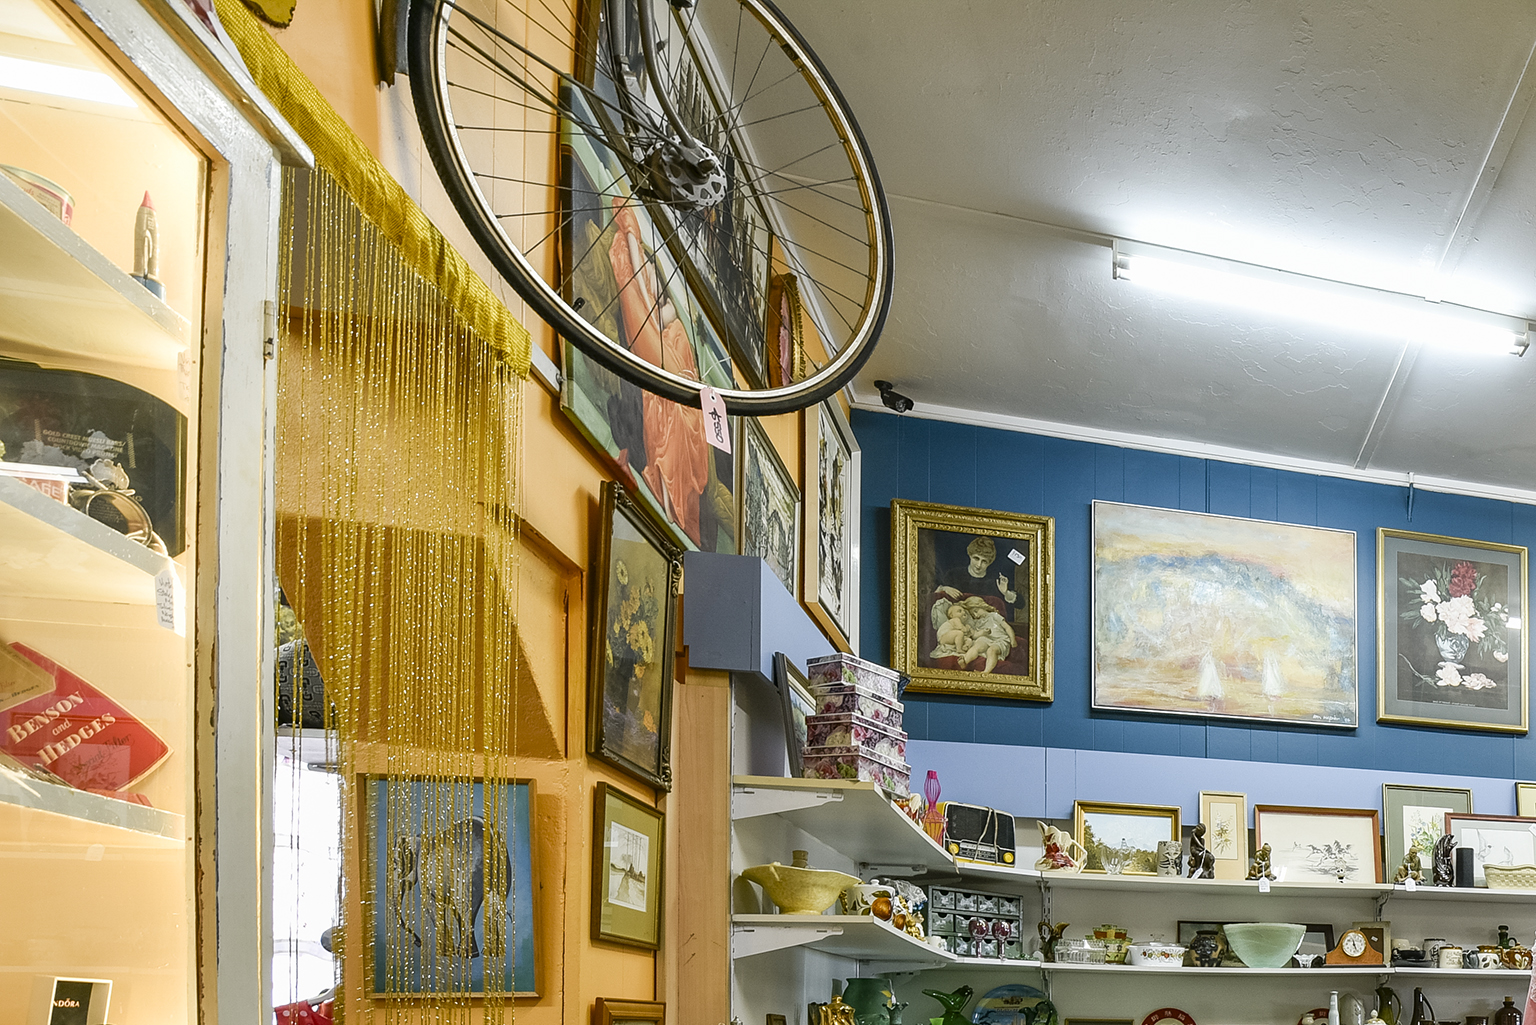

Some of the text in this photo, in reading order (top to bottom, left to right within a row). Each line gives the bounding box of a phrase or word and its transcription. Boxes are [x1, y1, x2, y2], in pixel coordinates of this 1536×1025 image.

[6, 690, 85, 744] BENSON
[36, 712, 116, 766] HEDGES
[51, 717, 72, 737] and
